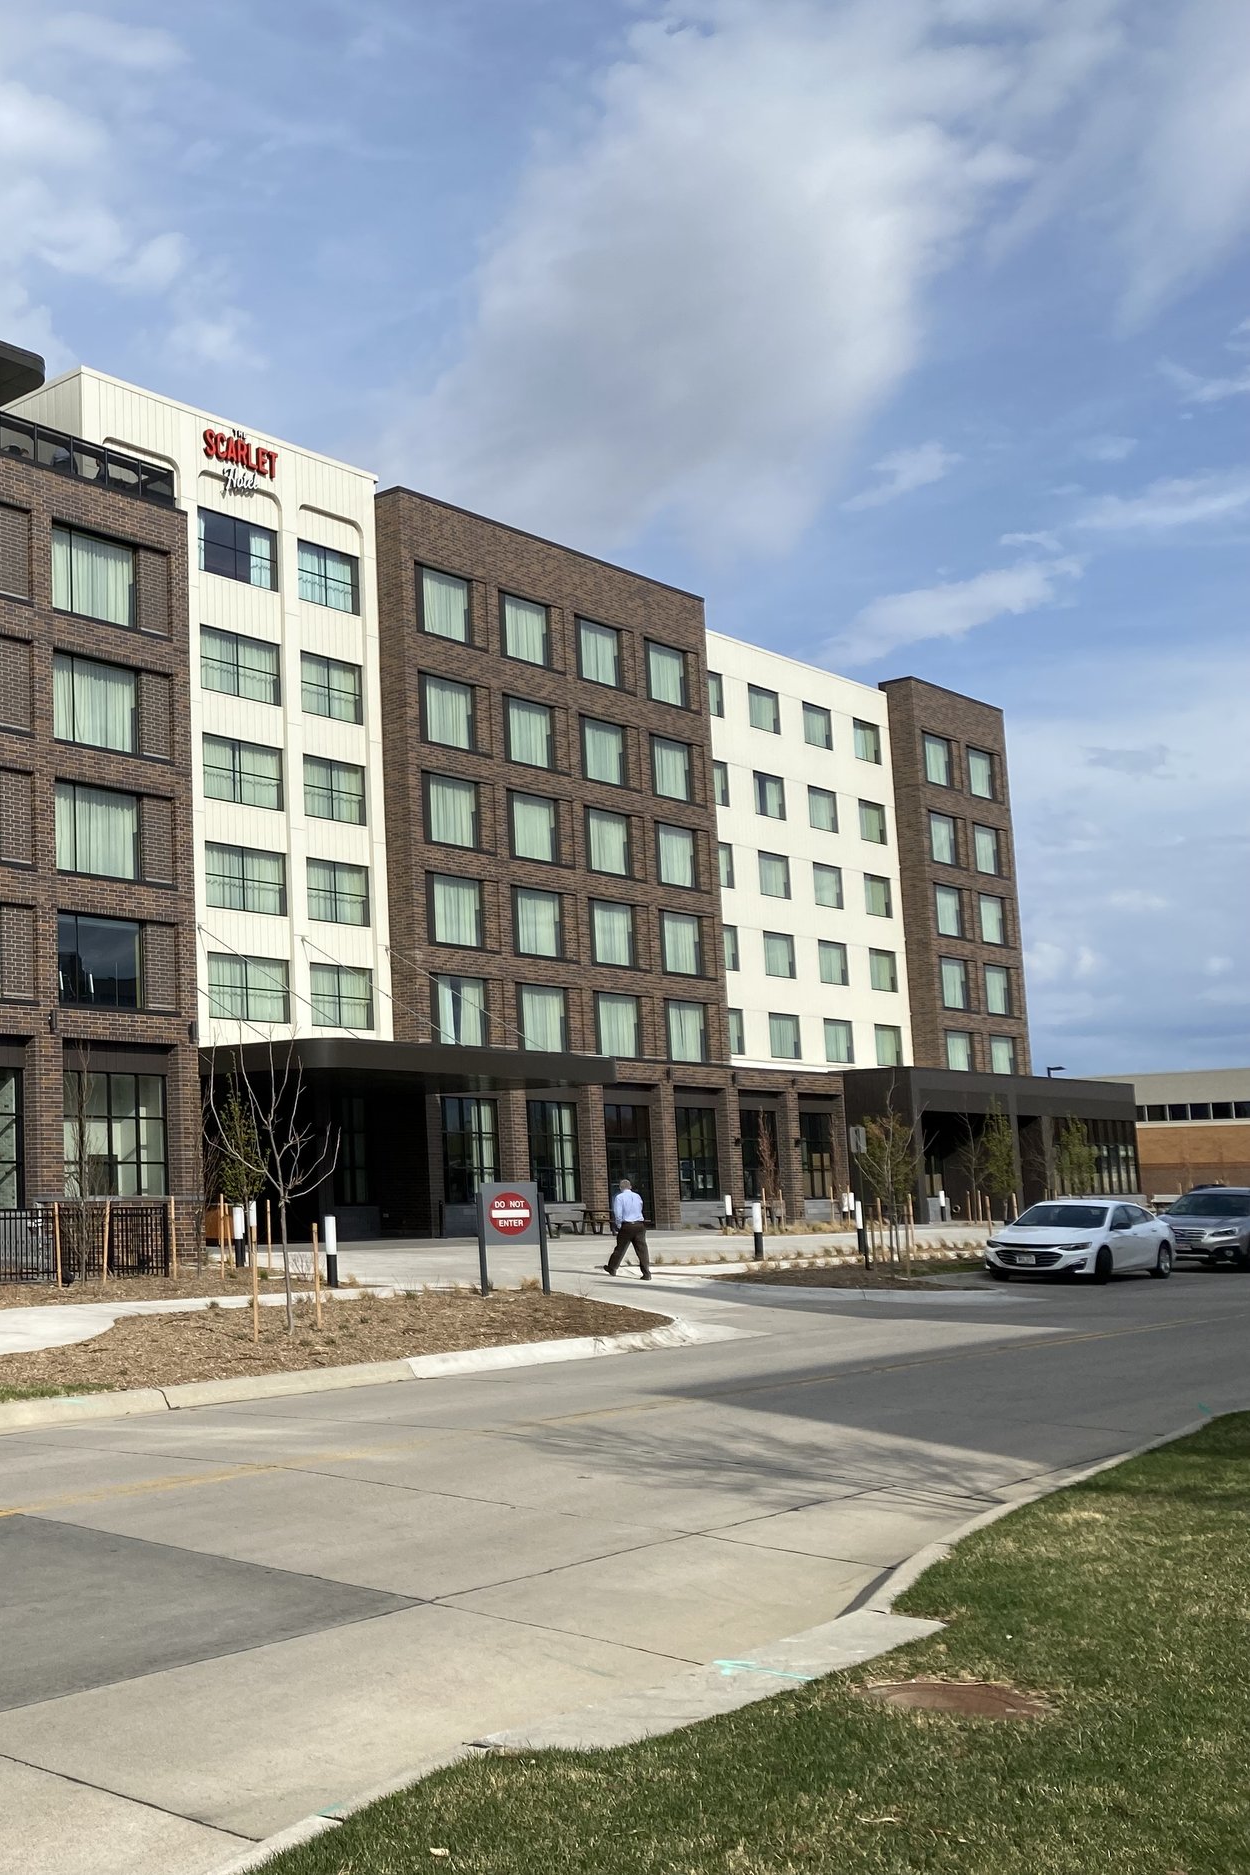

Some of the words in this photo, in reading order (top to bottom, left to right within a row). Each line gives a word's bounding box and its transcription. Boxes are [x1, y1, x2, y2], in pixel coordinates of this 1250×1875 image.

[203, 429, 278, 480] SCARLET
[223, 468, 259, 491] Hotel
[494, 1200, 506, 1209] DO
[509, 1200, 525, 1208] NOT
[498, 1219, 524, 1227] ENTER
